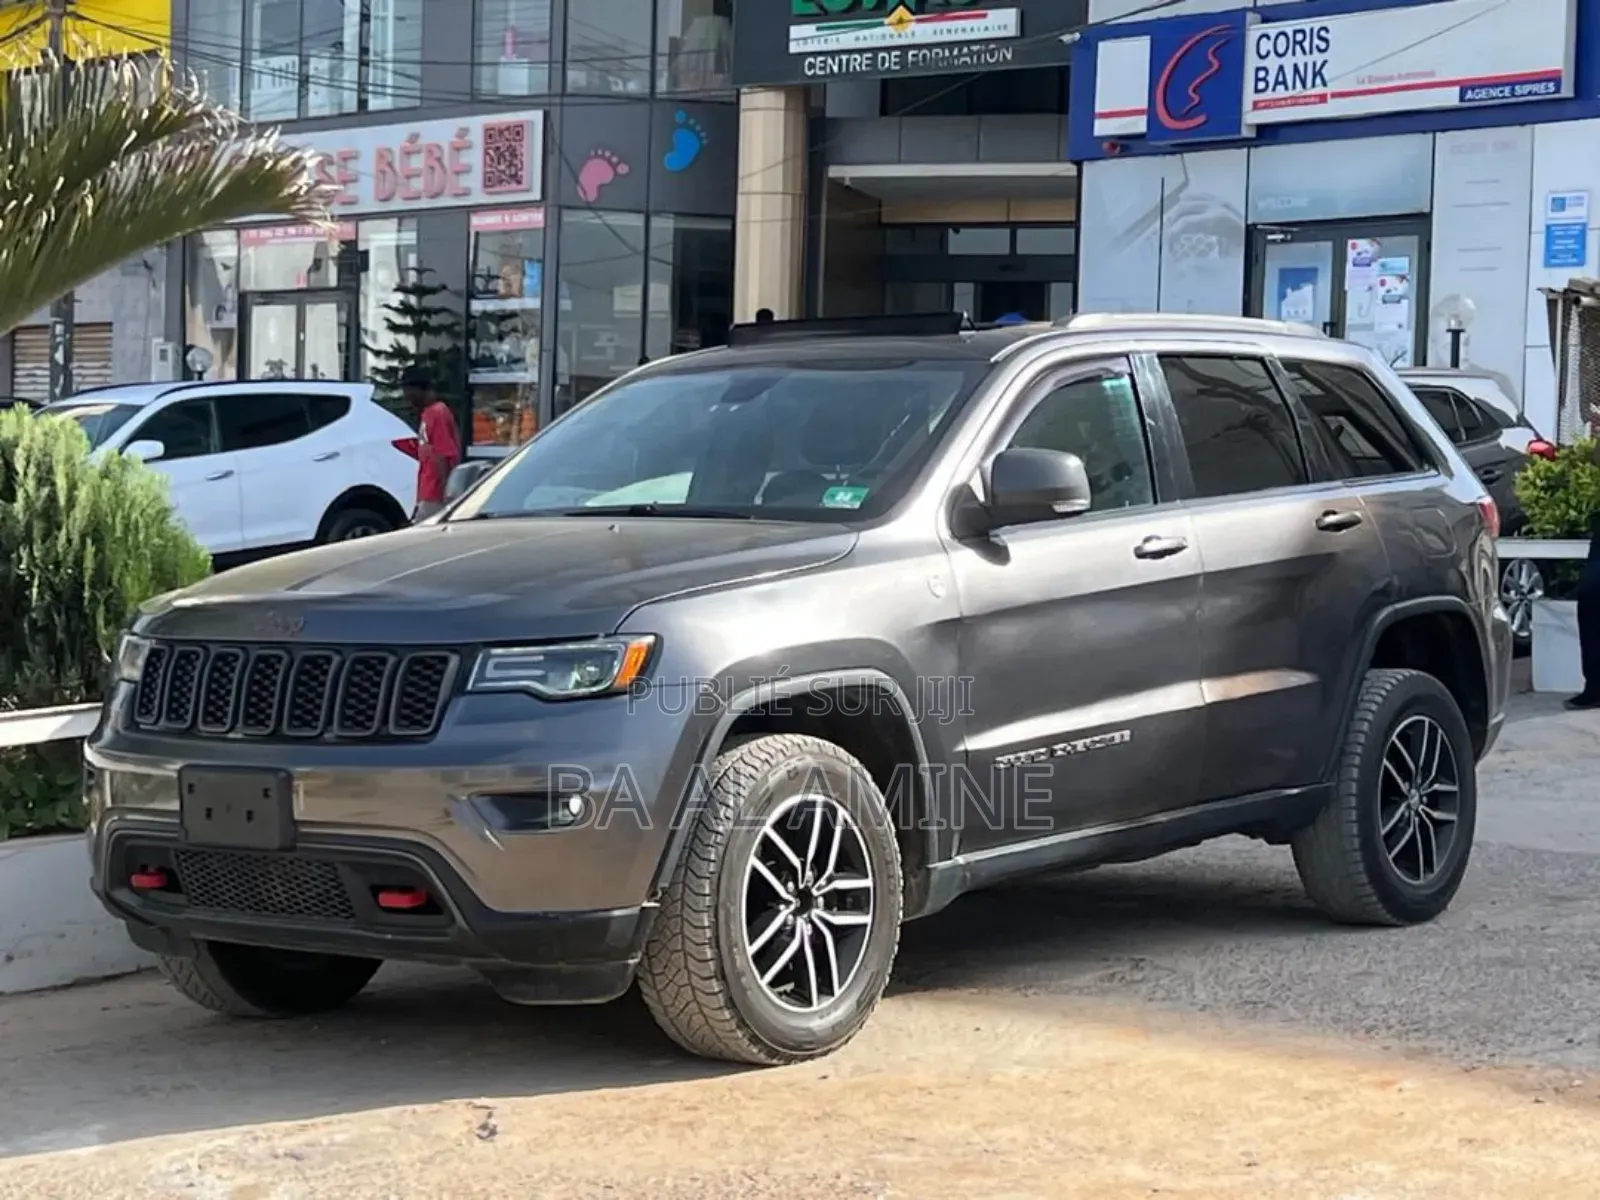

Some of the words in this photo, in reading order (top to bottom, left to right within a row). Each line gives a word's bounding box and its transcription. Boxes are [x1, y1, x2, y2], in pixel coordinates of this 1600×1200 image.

[803, 52, 873, 76] CENTRE
[878, 51, 901, 71] DE
[907, 44, 1013, 68] FORMATION
[1255, 26, 1330, 60] CORIS
[1253, 59, 1329, 94] BANK
[1464, 84, 1512, 101] AGENCE
[1513, 80, 1556, 96] SIPRES
[373, 127, 473, 203] BÉBÉ
